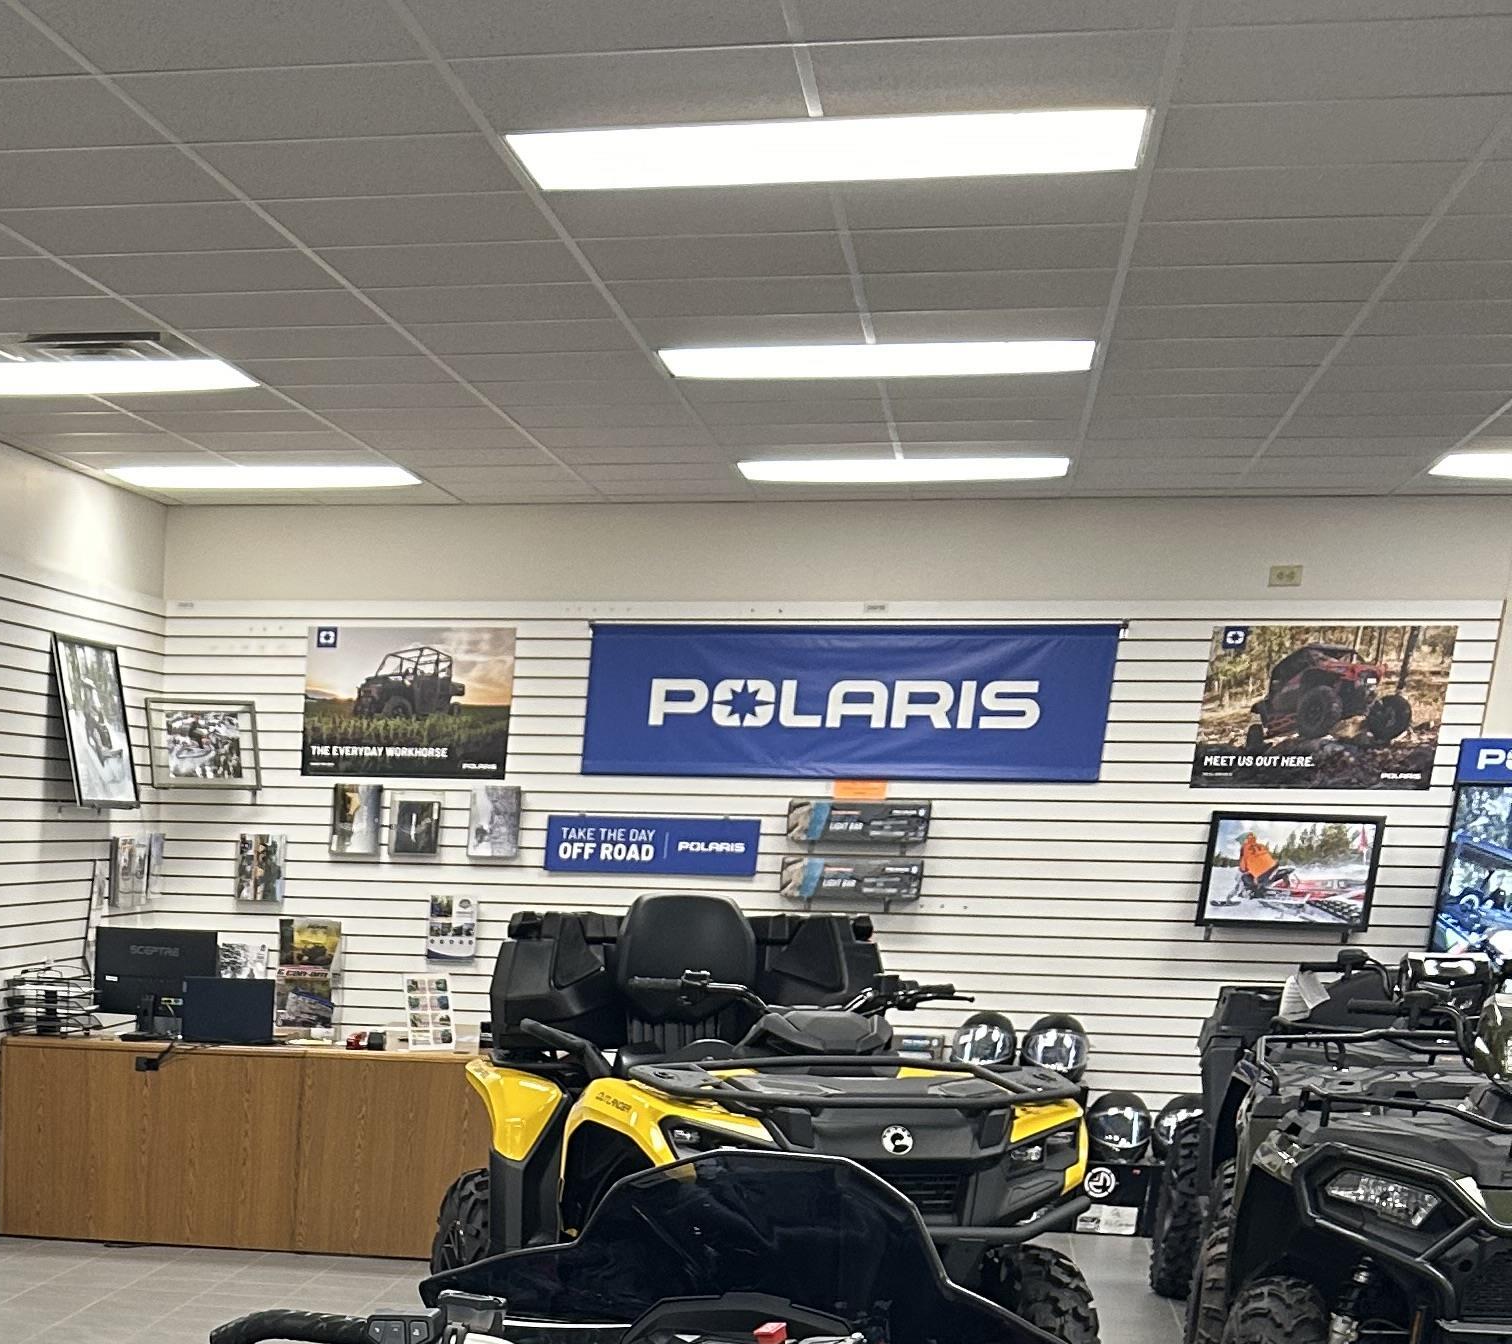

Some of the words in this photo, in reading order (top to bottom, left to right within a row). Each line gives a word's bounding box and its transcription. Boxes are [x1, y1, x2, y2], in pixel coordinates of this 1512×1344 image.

[648, 678, 1041, 729] POLARIS
[310, 745, 331, 757] THE
[332, 745, 383, 757] EVERYDAY
[385, 746, 448, 758] WORKHORSE
[1203, 755, 1235, 767] MEET
[1237, 755, 1253, 767] US
[1255, 756, 1279, 767] OUT
[1280, 756, 1316, 768] HERE.
[561, 827, 595, 841] TAKE
[599, 828, 626, 841] THE
[629, 829, 656, 842] DAY
[558, 842, 595, 859] OFF
[599, 843, 655, 861] ROAD
[677, 841, 746, 853] POLARIS
